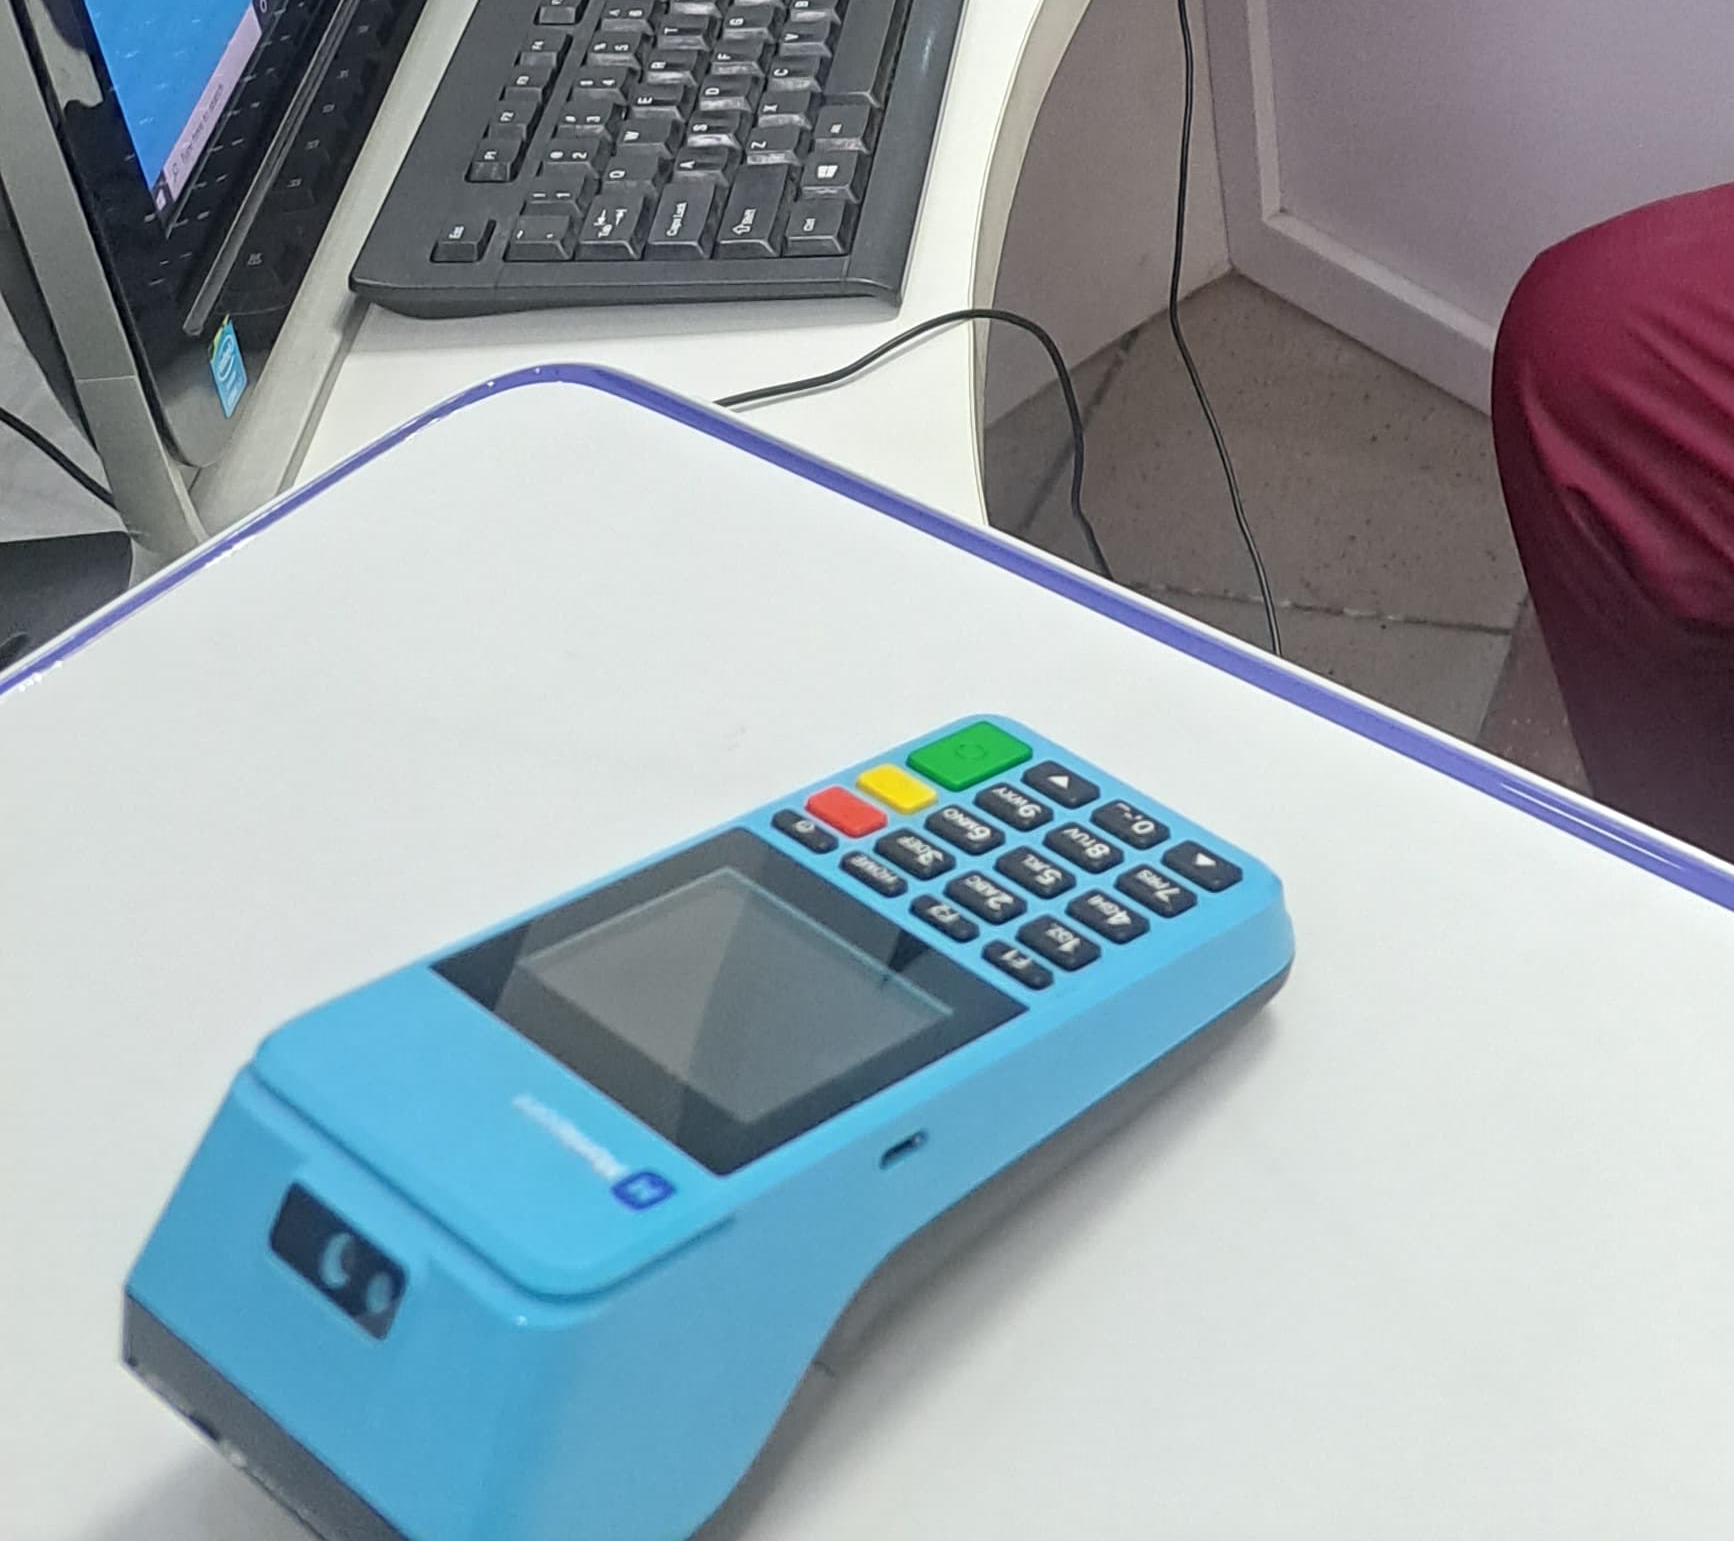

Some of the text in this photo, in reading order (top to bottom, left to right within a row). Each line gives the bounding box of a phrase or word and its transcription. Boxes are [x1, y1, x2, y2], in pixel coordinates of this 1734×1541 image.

[500, 112, 514, 121] F2
[572, 151, 587, 159] 2
[587, 115, 601, 123] 3
[609, 170, 625, 178] Q
[664, 27, 678, 35] T
[680, 160, 695, 168] A
[730, 18, 743, 26] G
[751, 141, 767, 149] Z
[763, 104, 778, 112] X
[774, 69, 788, 77] C
[785, 33, 799, 41] V
